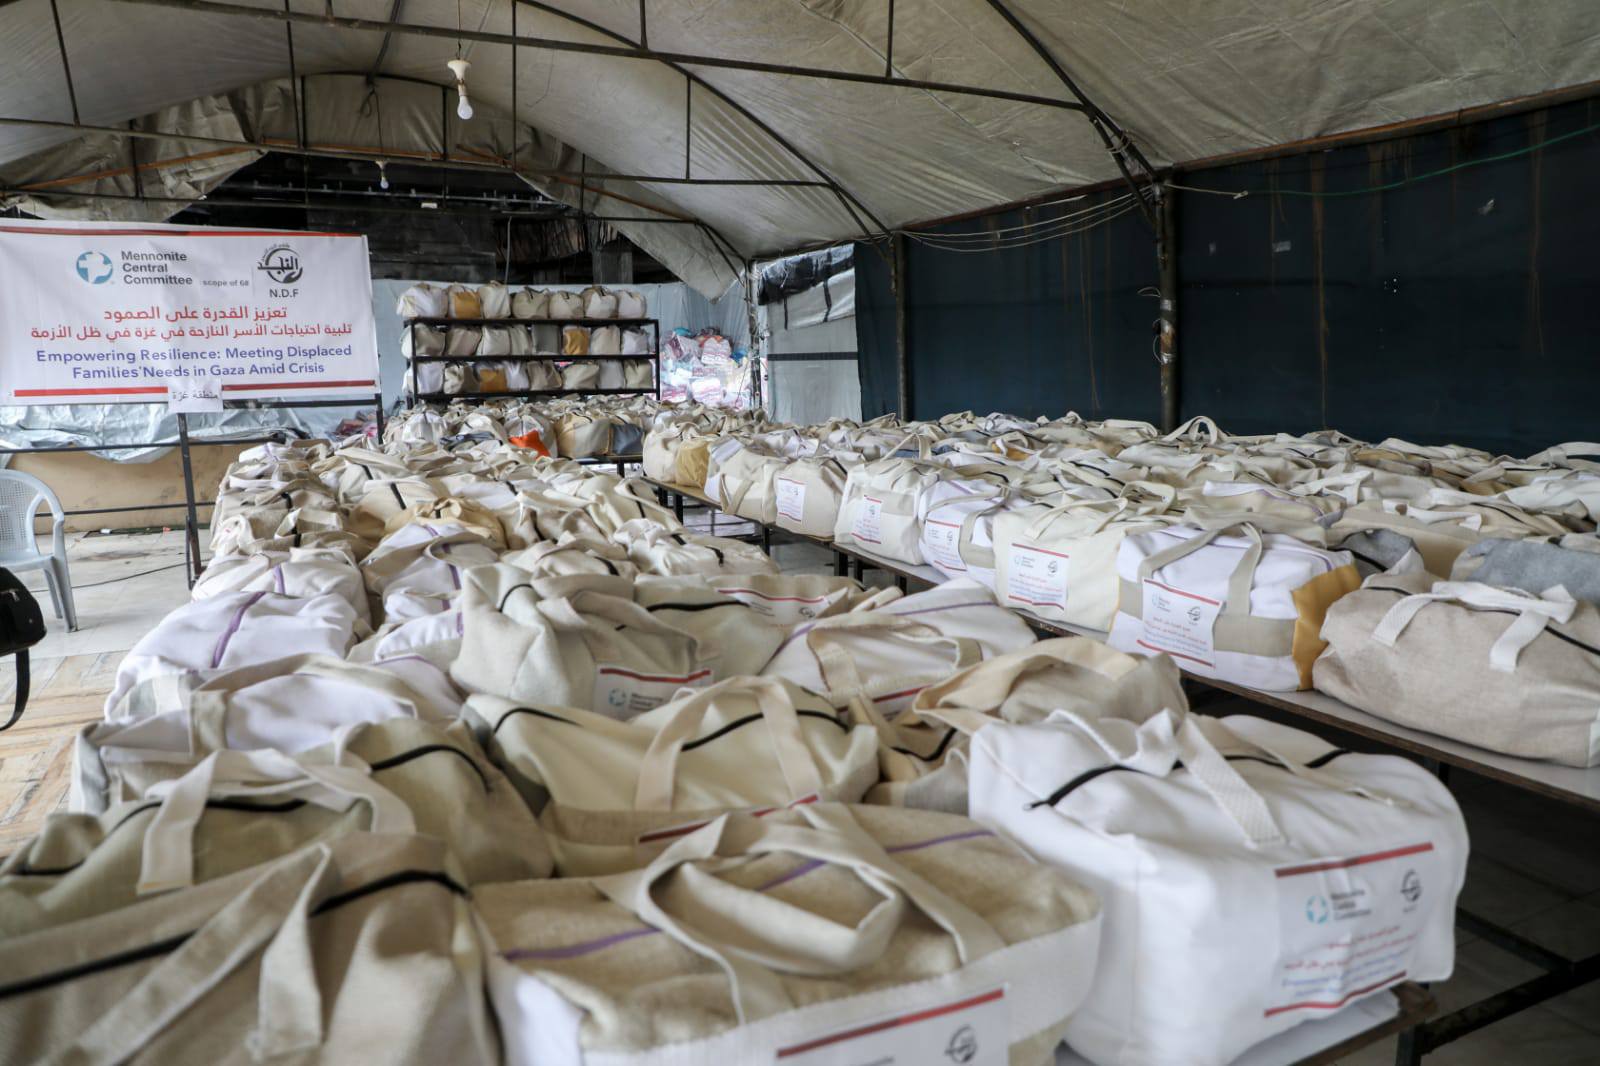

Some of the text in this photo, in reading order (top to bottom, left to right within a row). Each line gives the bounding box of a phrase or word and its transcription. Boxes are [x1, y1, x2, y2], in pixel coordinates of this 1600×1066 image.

[121, 250, 188, 261] Mennonite
[122, 262, 168, 273] Central
[123, 274, 193, 285] Committee
[269, 288, 299, 298] N.D.F
[104, 305, 288, 323] تعزيز القدرة على الصمود
[31, 323, 72, 341] الأزمة
[76, 324, 102, 341] ظل
[105, 328, 131, 343] في
[134, 327, 157, 341] غزة
[161, 327, 185, 342] في
[188, 324, 229, 339] النازحة
[270, 323, 320, 338] احتياجات
[324, 322, 353, 337] تلبية
[36, 344, 352, 365] Empowering Resilience: Meeting Displaced
[143, 364, 190, 378] Needs
[193, 365, 206, 377] in
[210, 364, 245, 376] Gaza
[249, 363, 285, 375] Amid
[288, 362, 325, 374] Crisis
